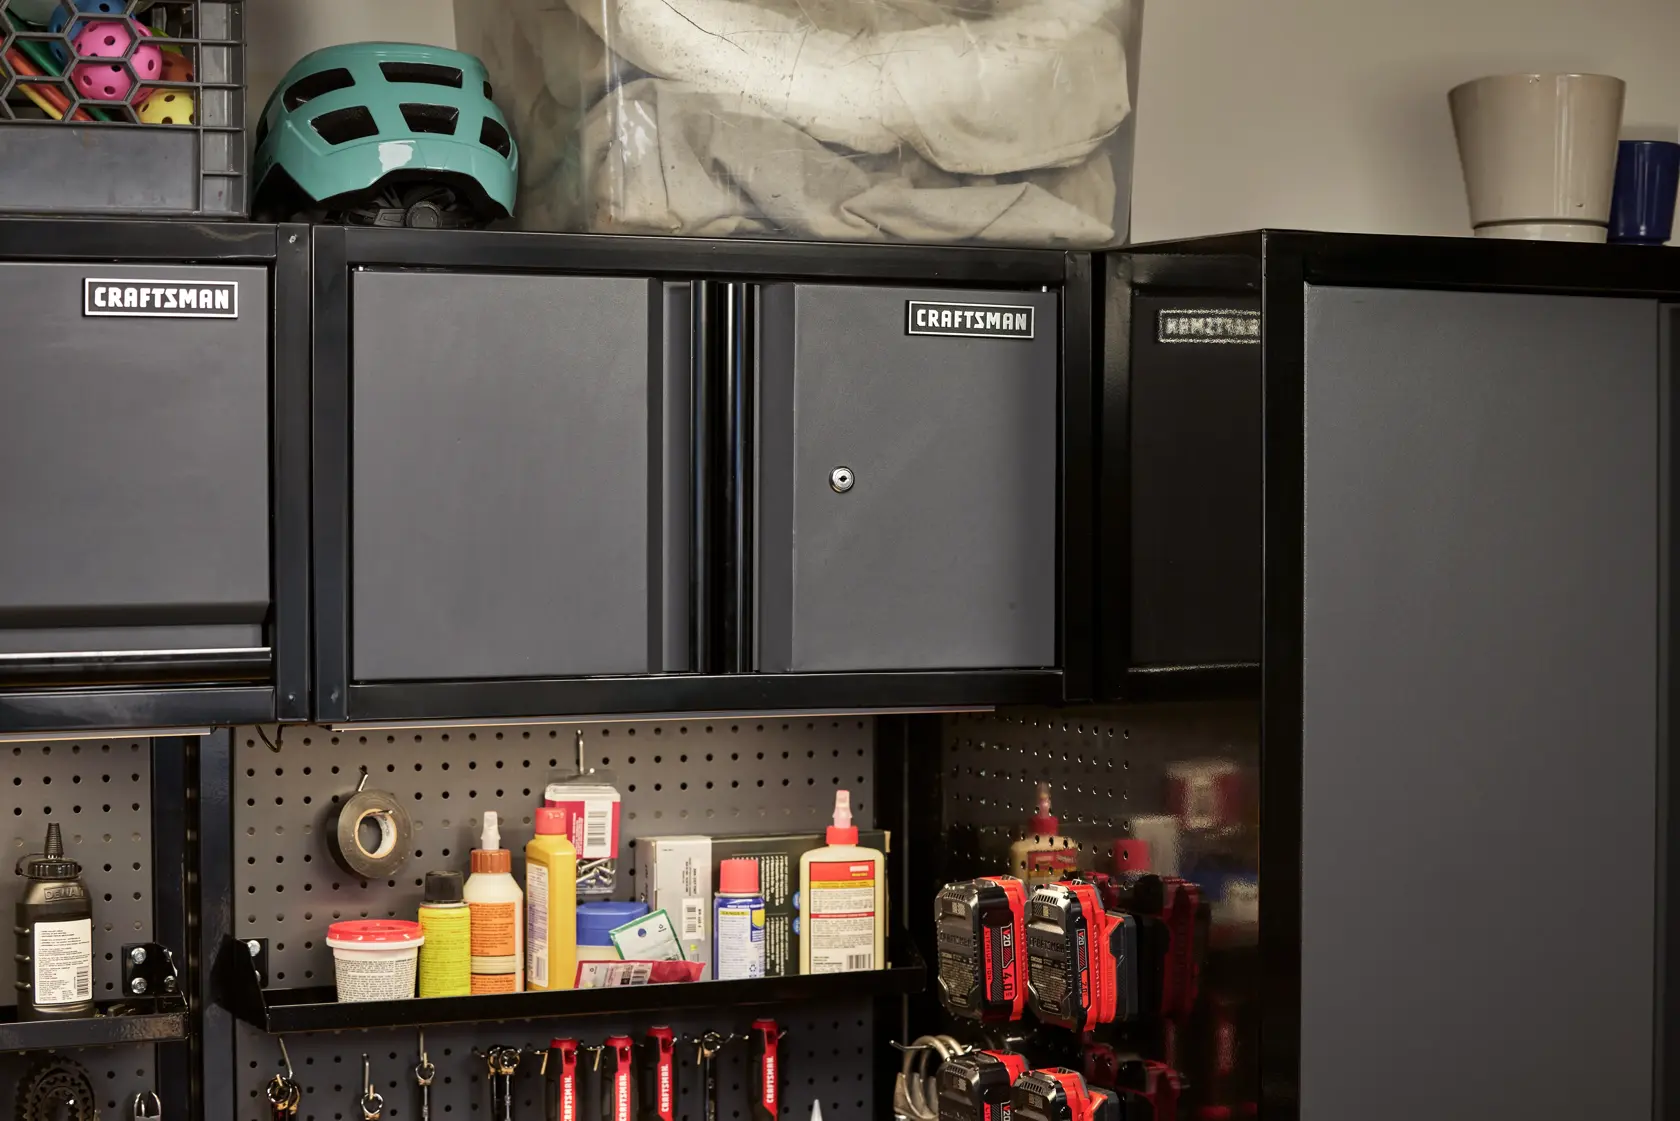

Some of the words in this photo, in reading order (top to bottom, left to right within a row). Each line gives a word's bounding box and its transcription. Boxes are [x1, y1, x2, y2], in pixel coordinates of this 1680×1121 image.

[94, 286, 229, 310] CRAFTSMAN
[916, 308, 1027, 331] CRAFTSMAN
[1002, 929, 1012, 947] V20
[661, 1064, 669, 1112] CRAFTSMAN
